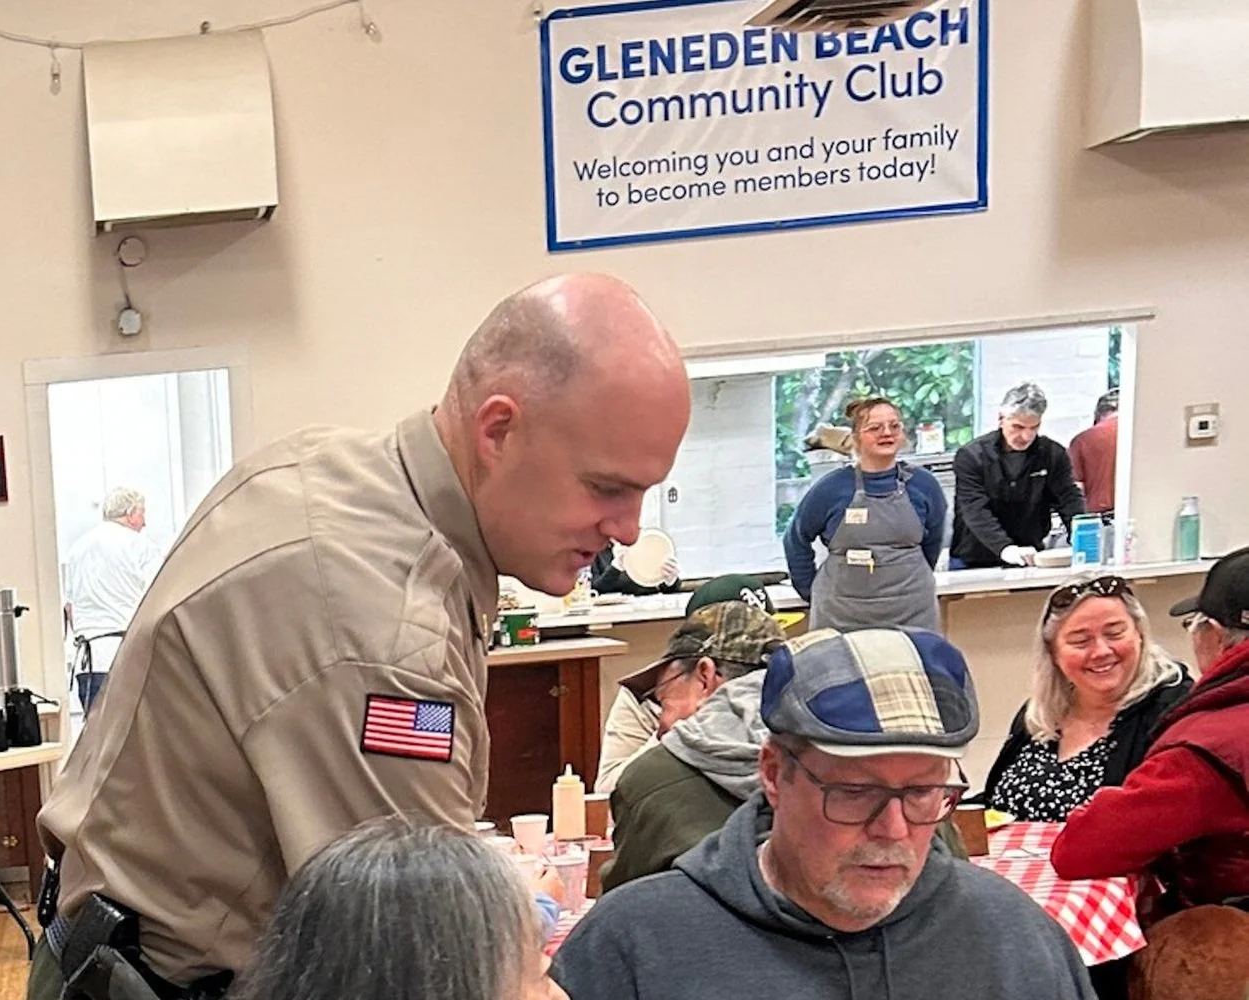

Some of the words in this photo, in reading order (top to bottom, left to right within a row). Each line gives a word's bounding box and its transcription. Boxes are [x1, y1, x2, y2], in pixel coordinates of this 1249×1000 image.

[559, 28, 798, 85] GLENEDEN
[815, 7, 969, 60] BEACH
[586, 71, 834, 128] Community
[845, 57, 943, 102] Club
[574, 150, 709, 181] Welcoming
[716, 149, 759, 173] you
[766, 137, 815, 162] and
[822, 137, 877, 163] your
[882, 124, 959, 151] family
[596, 187, 620, 208] to
[627, 179, 727, 204] become
[733, 166, 851, 194] members
[857, 155, 937, 182] today!
